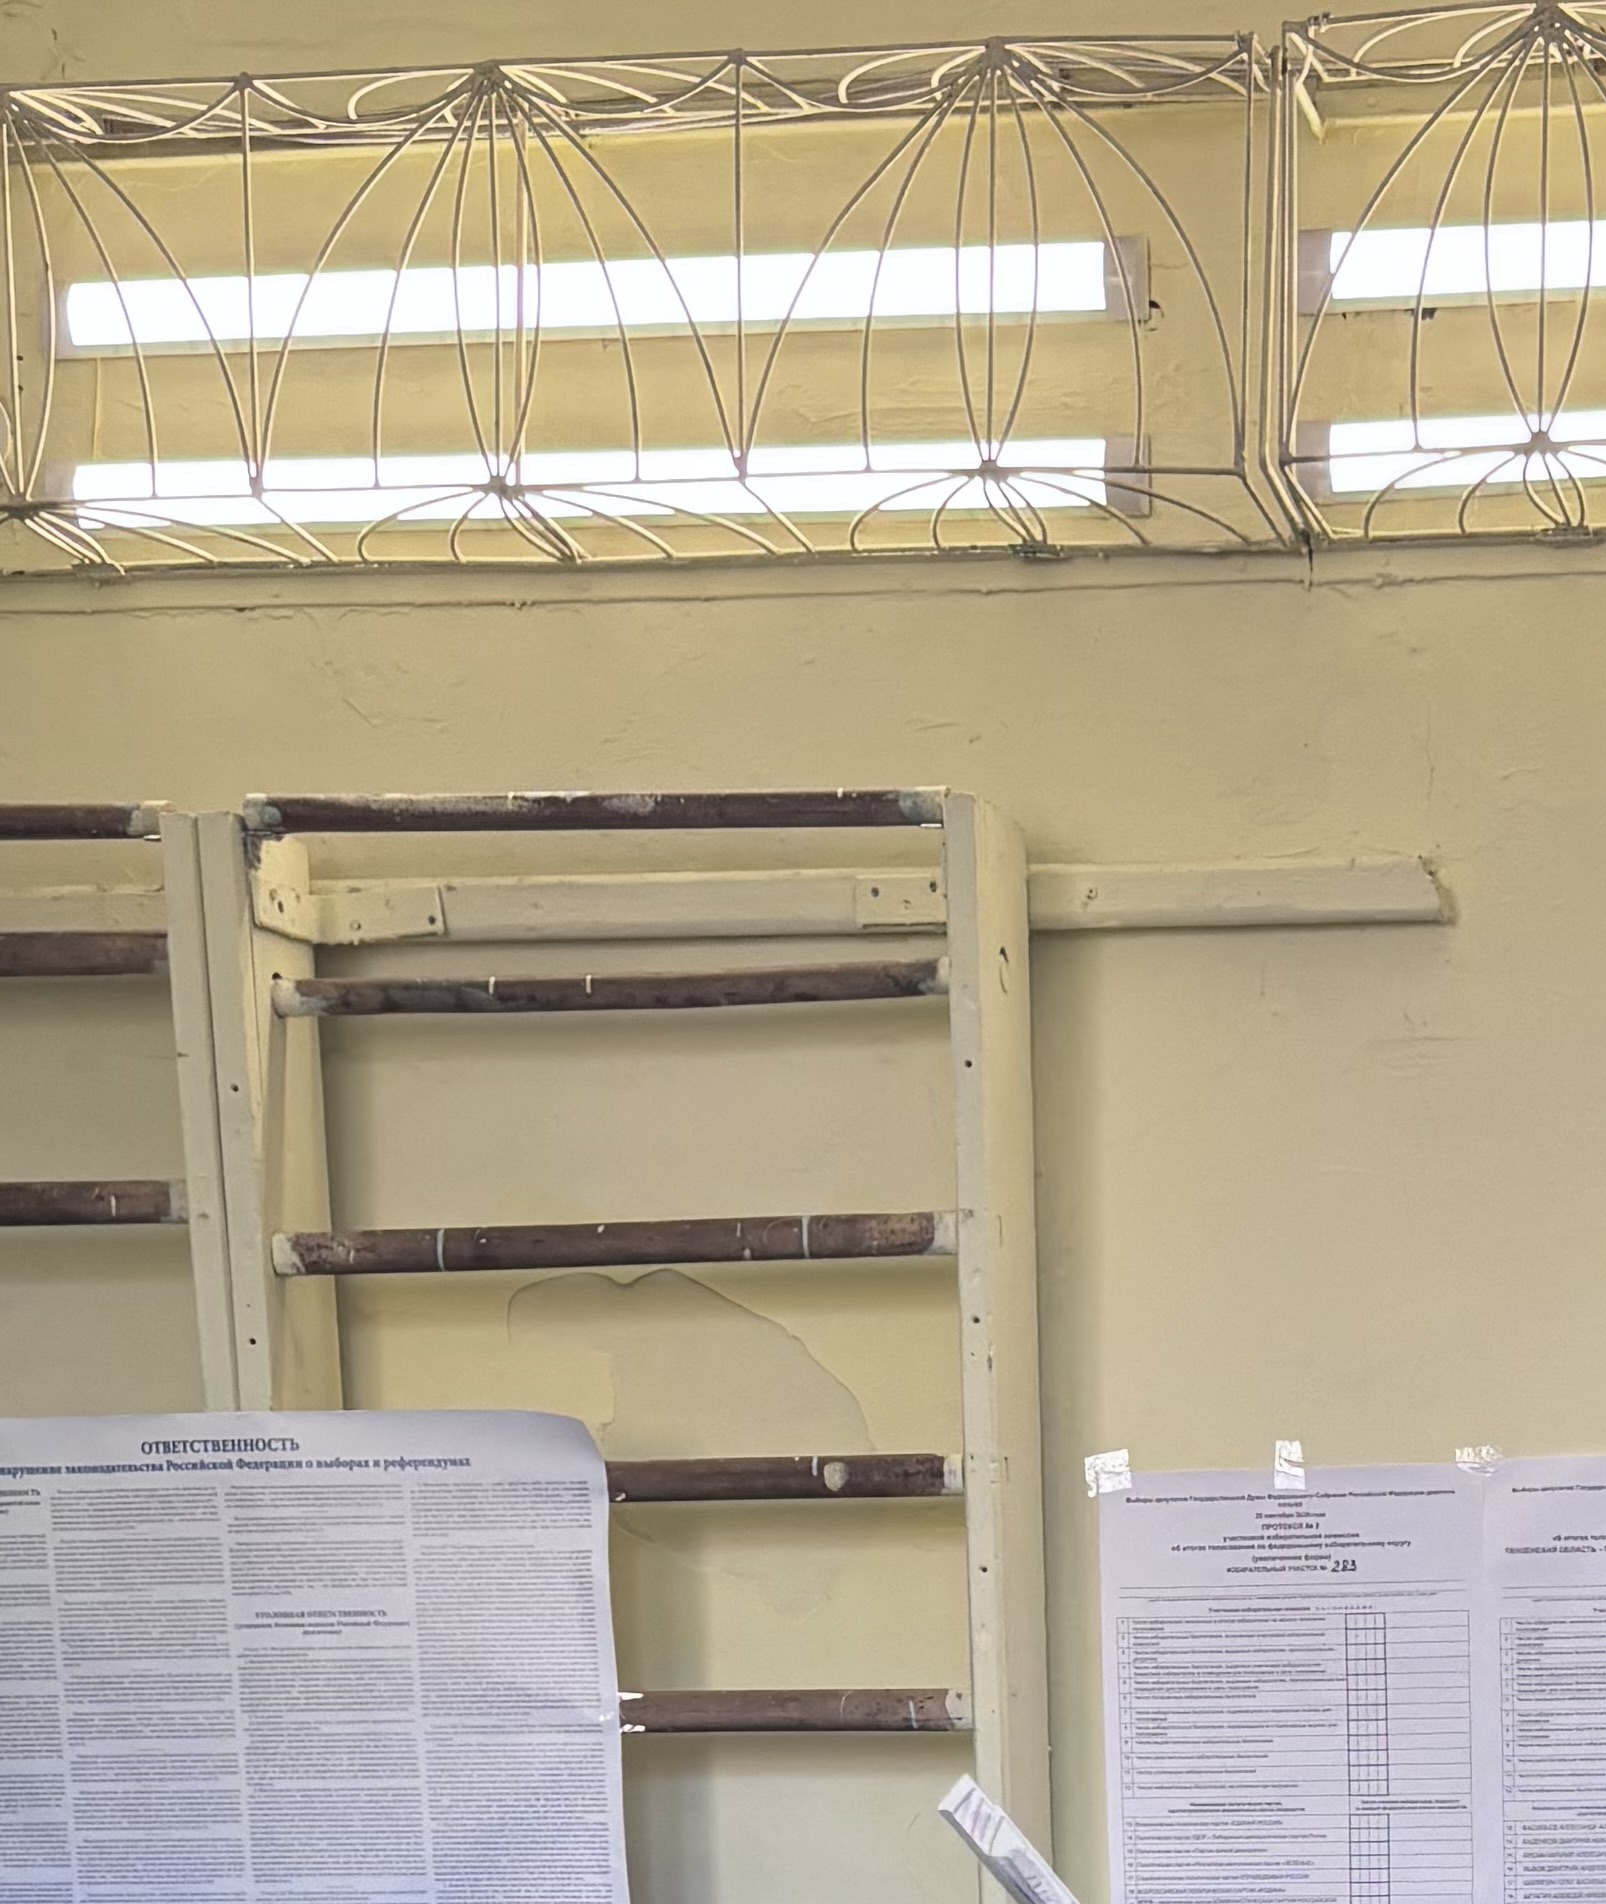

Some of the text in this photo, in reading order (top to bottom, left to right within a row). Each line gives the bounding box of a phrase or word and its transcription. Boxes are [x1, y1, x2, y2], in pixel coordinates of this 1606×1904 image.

[140, 1438, 300, 1455] ОТВЕТСТВЕННОСТЬ
[166, 1459, 233, 1472] Российской
[236, 1457, 303, 1472] Федерации
[1331, 1559, 1357, 1573] 283
